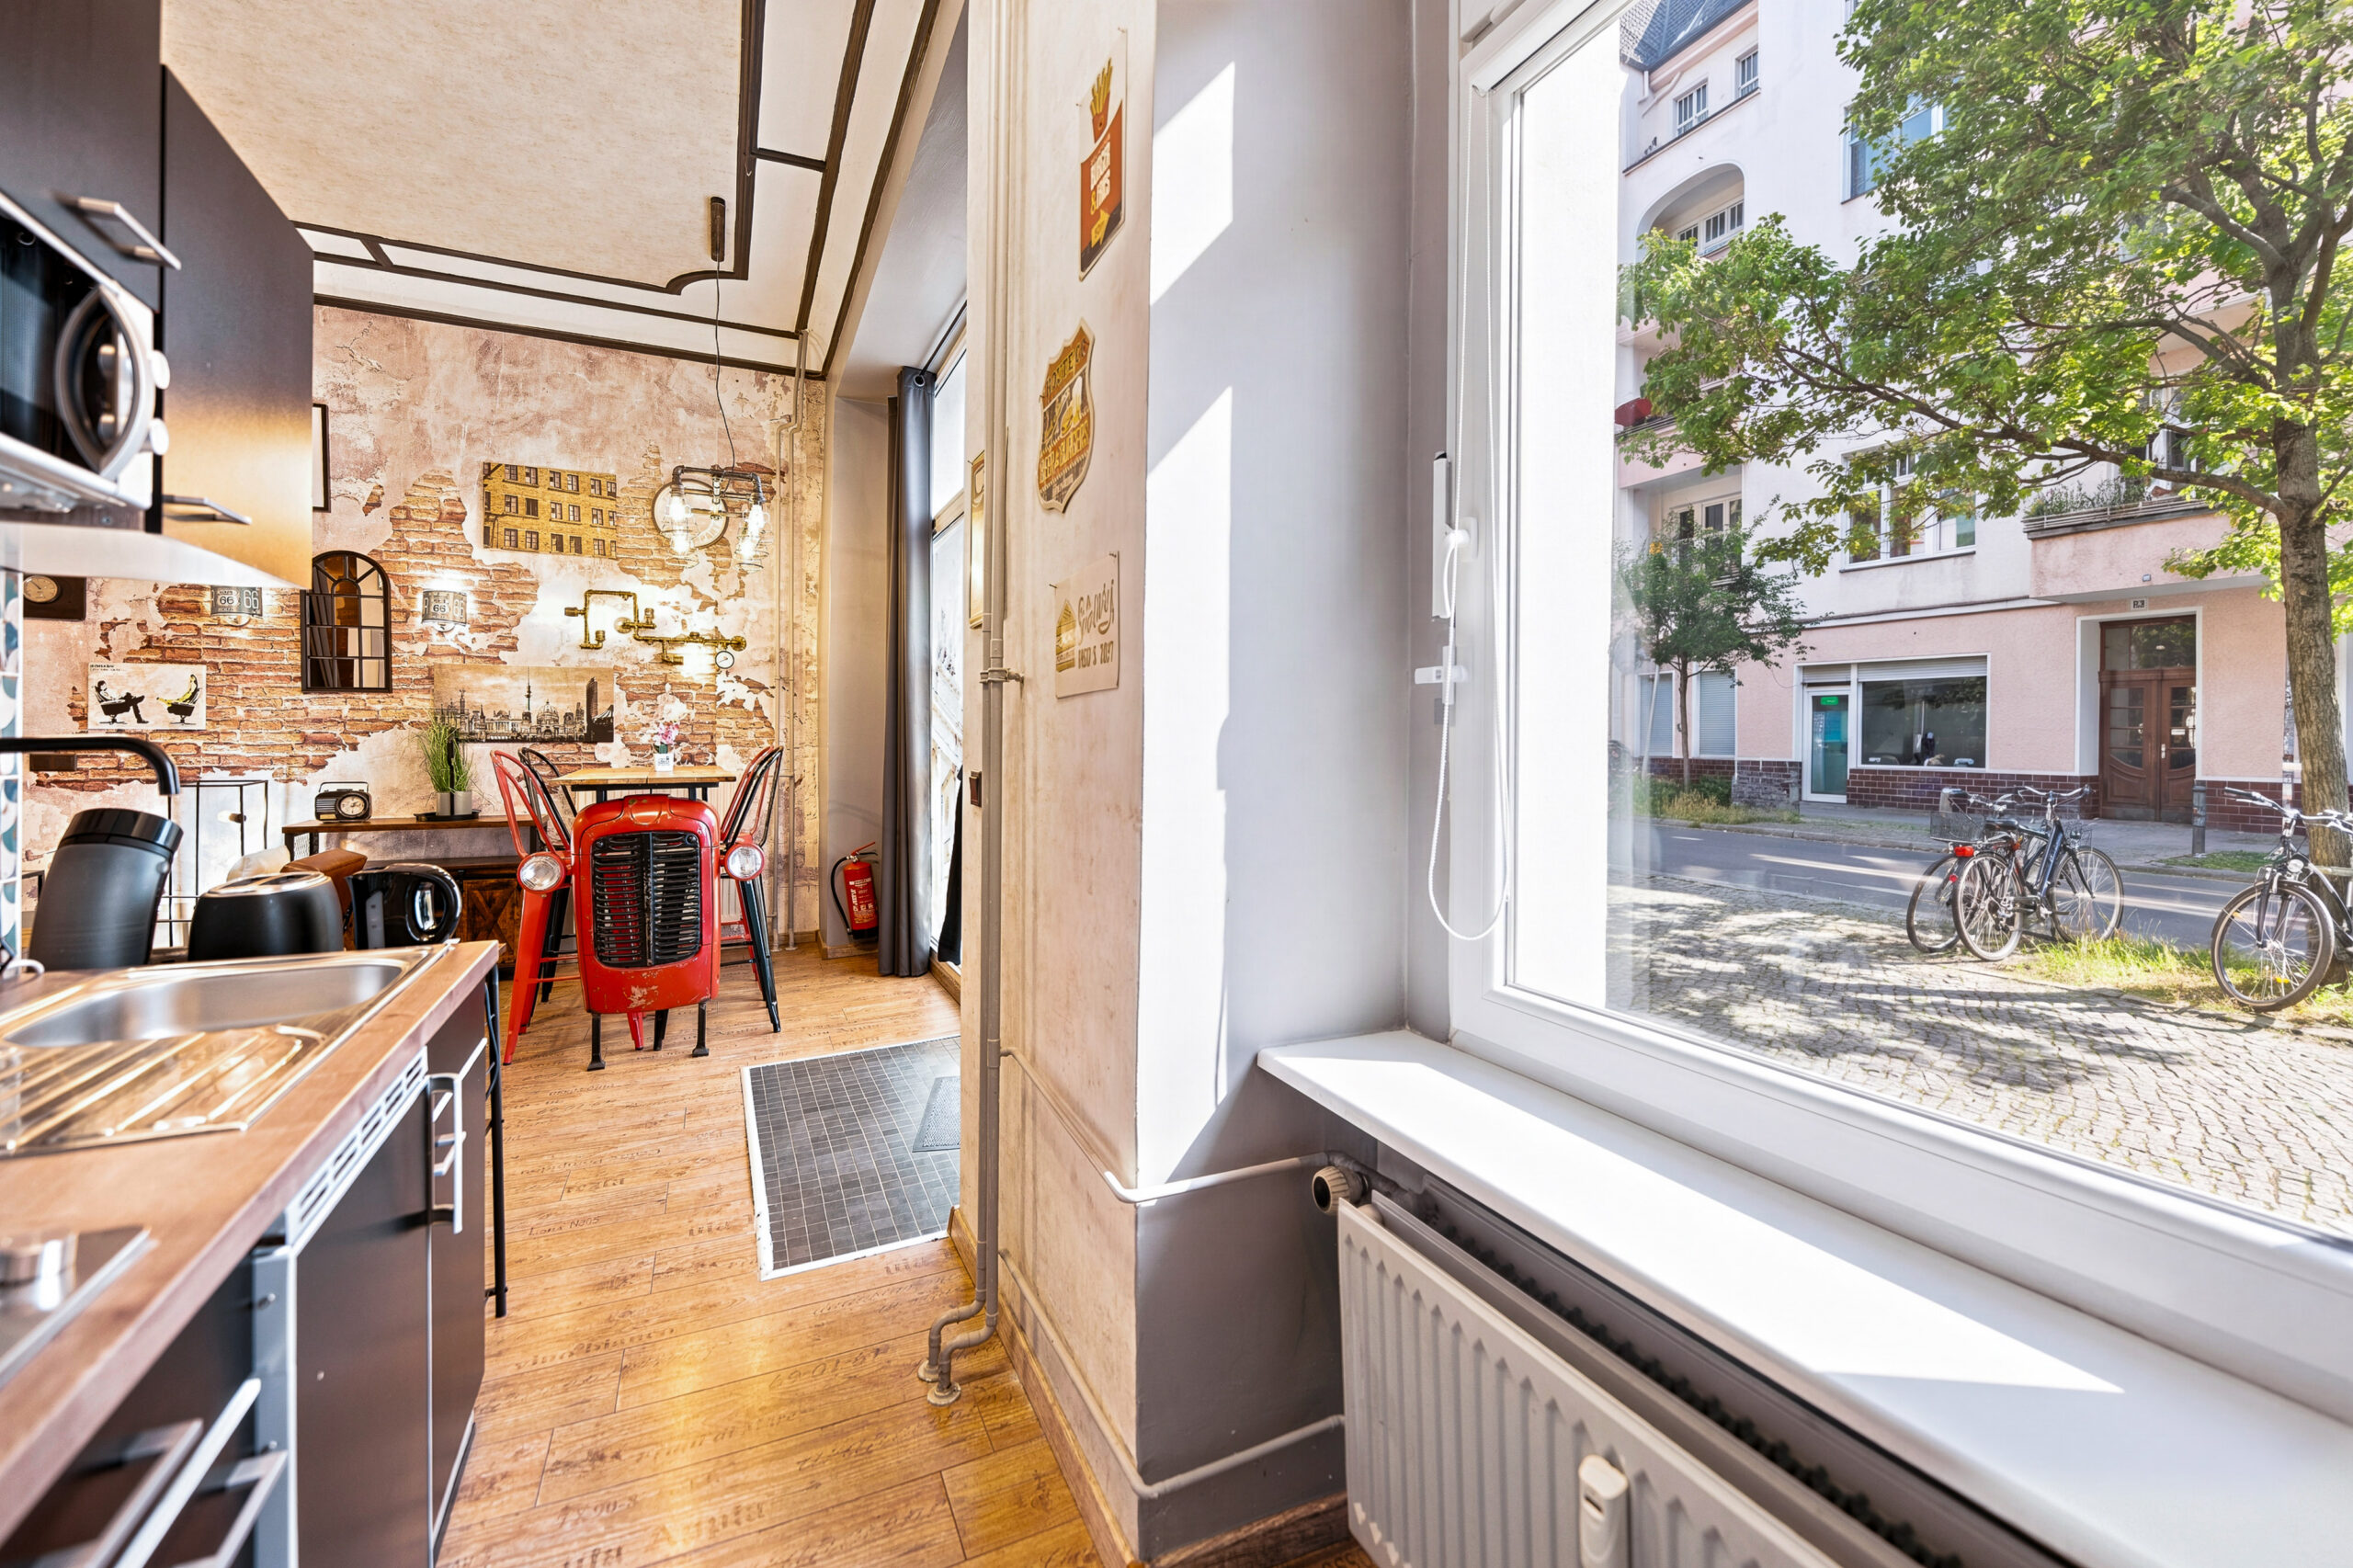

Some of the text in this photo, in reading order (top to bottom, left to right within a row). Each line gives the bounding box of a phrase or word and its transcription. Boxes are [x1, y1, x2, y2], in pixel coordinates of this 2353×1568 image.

[220, 596, 234, 605] 66
[244, 589, 258, 609] 66
[433, 604, 446, 613] 66
